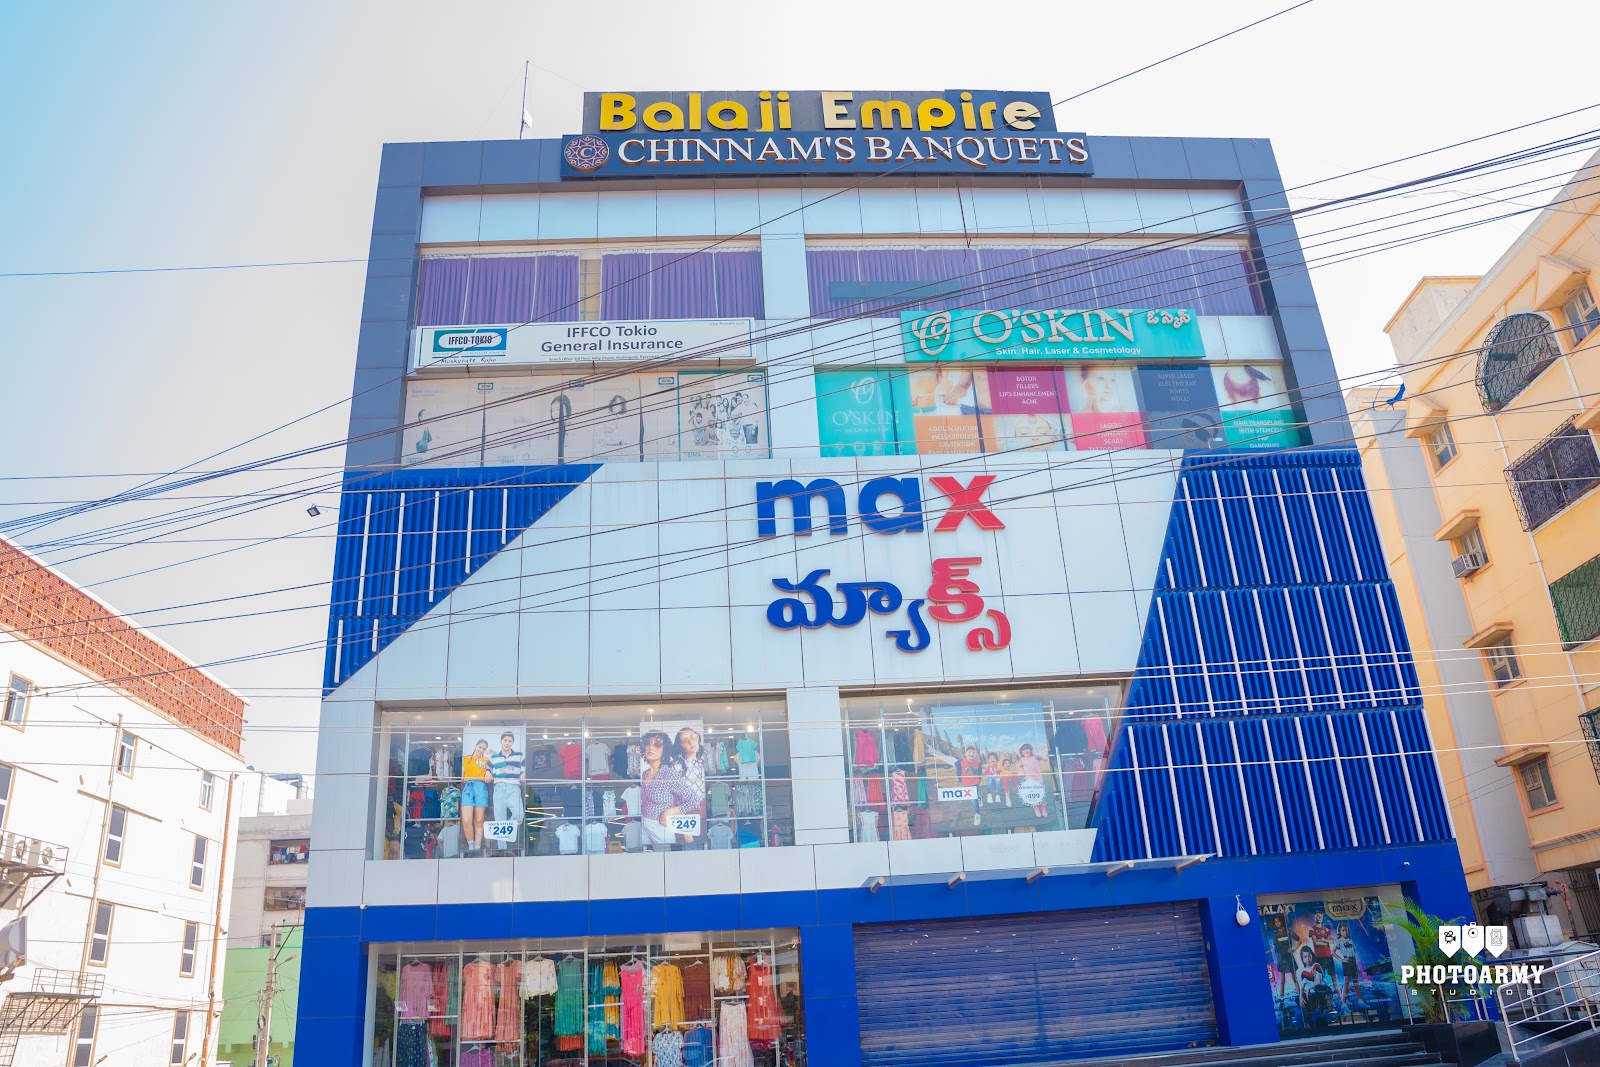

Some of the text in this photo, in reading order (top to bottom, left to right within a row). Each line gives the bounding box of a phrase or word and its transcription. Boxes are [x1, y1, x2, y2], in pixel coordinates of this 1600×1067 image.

[600, 91, 1041, 132] Balaji Empire
[618, 136, 1089, 169] CHINNAM'S BANQUETS
[567, 325, 658, 338] IFFCO Tokio
[972, 309, 1135, 343] O'SKIN
[541, 339, 684, 352] General Insurance
[996, 345, 1141, 356] Skin, Hair, Laser & Cosmetology
[832, 410, 900, 426] O'SKIN
[756, 475, 1006, 537] max
[767, 557, 1011, 653] మ్యాక్స్
[942, 787, 972, 799] max
[1332, 903, 1358, 912] max
